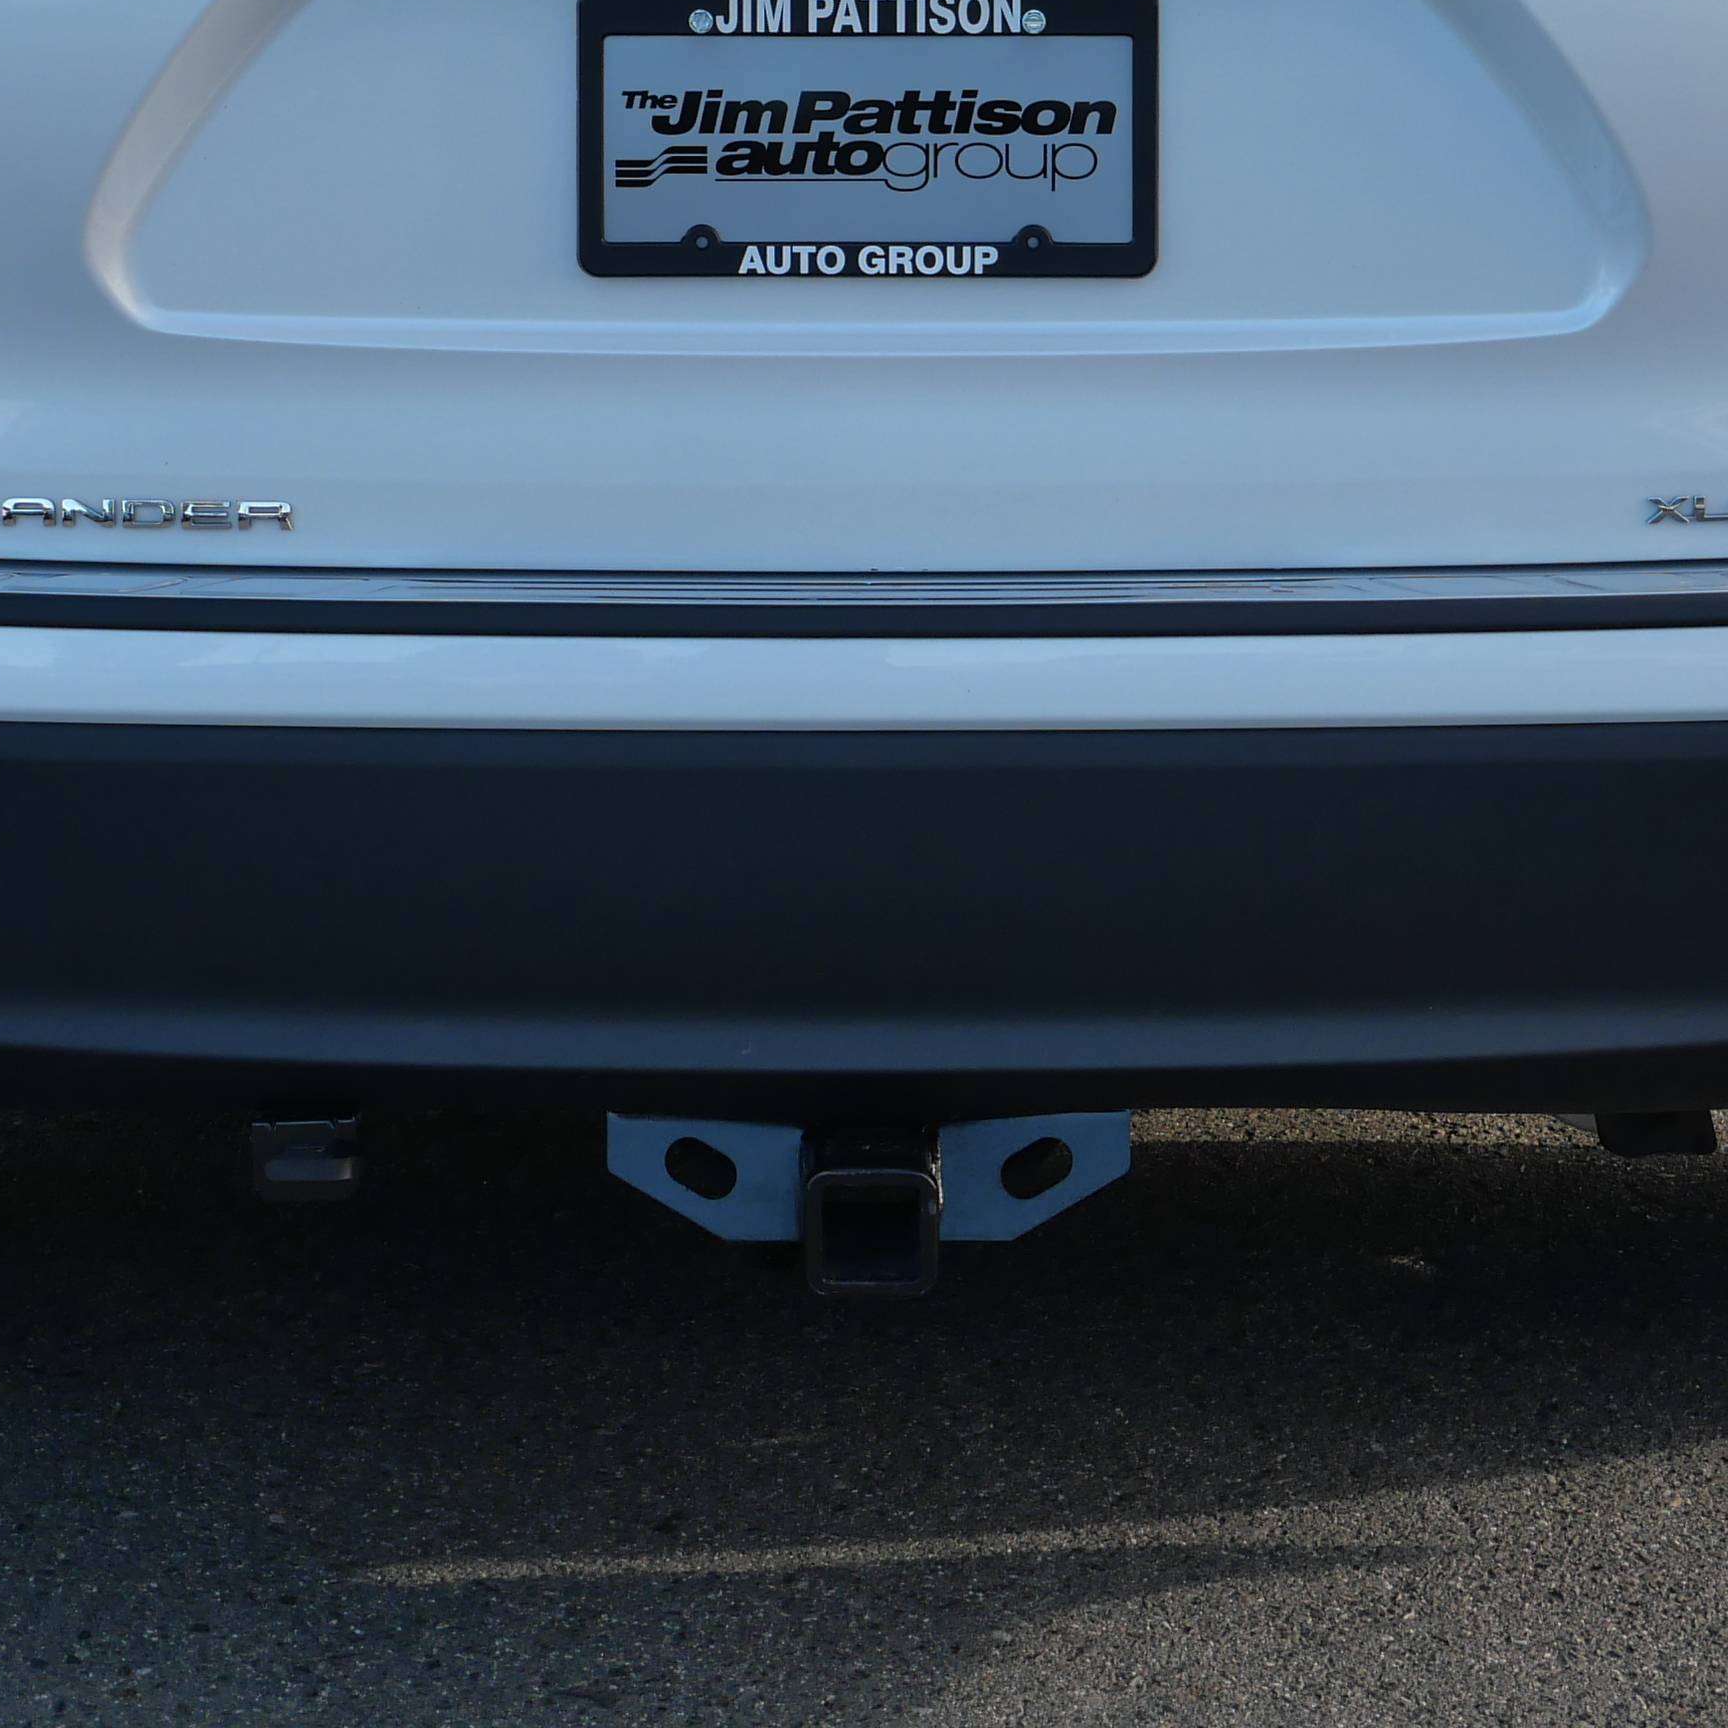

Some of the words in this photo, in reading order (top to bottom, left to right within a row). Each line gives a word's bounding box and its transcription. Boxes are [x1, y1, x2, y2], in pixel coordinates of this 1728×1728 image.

[621, 90, 678, 110] The
[651, 89, 787, 136] Jim
[793, 89, 1117, 136] Pattison
[738, 246, 845, 275] AUTO
[857, 246, 999, 275] GROUP
